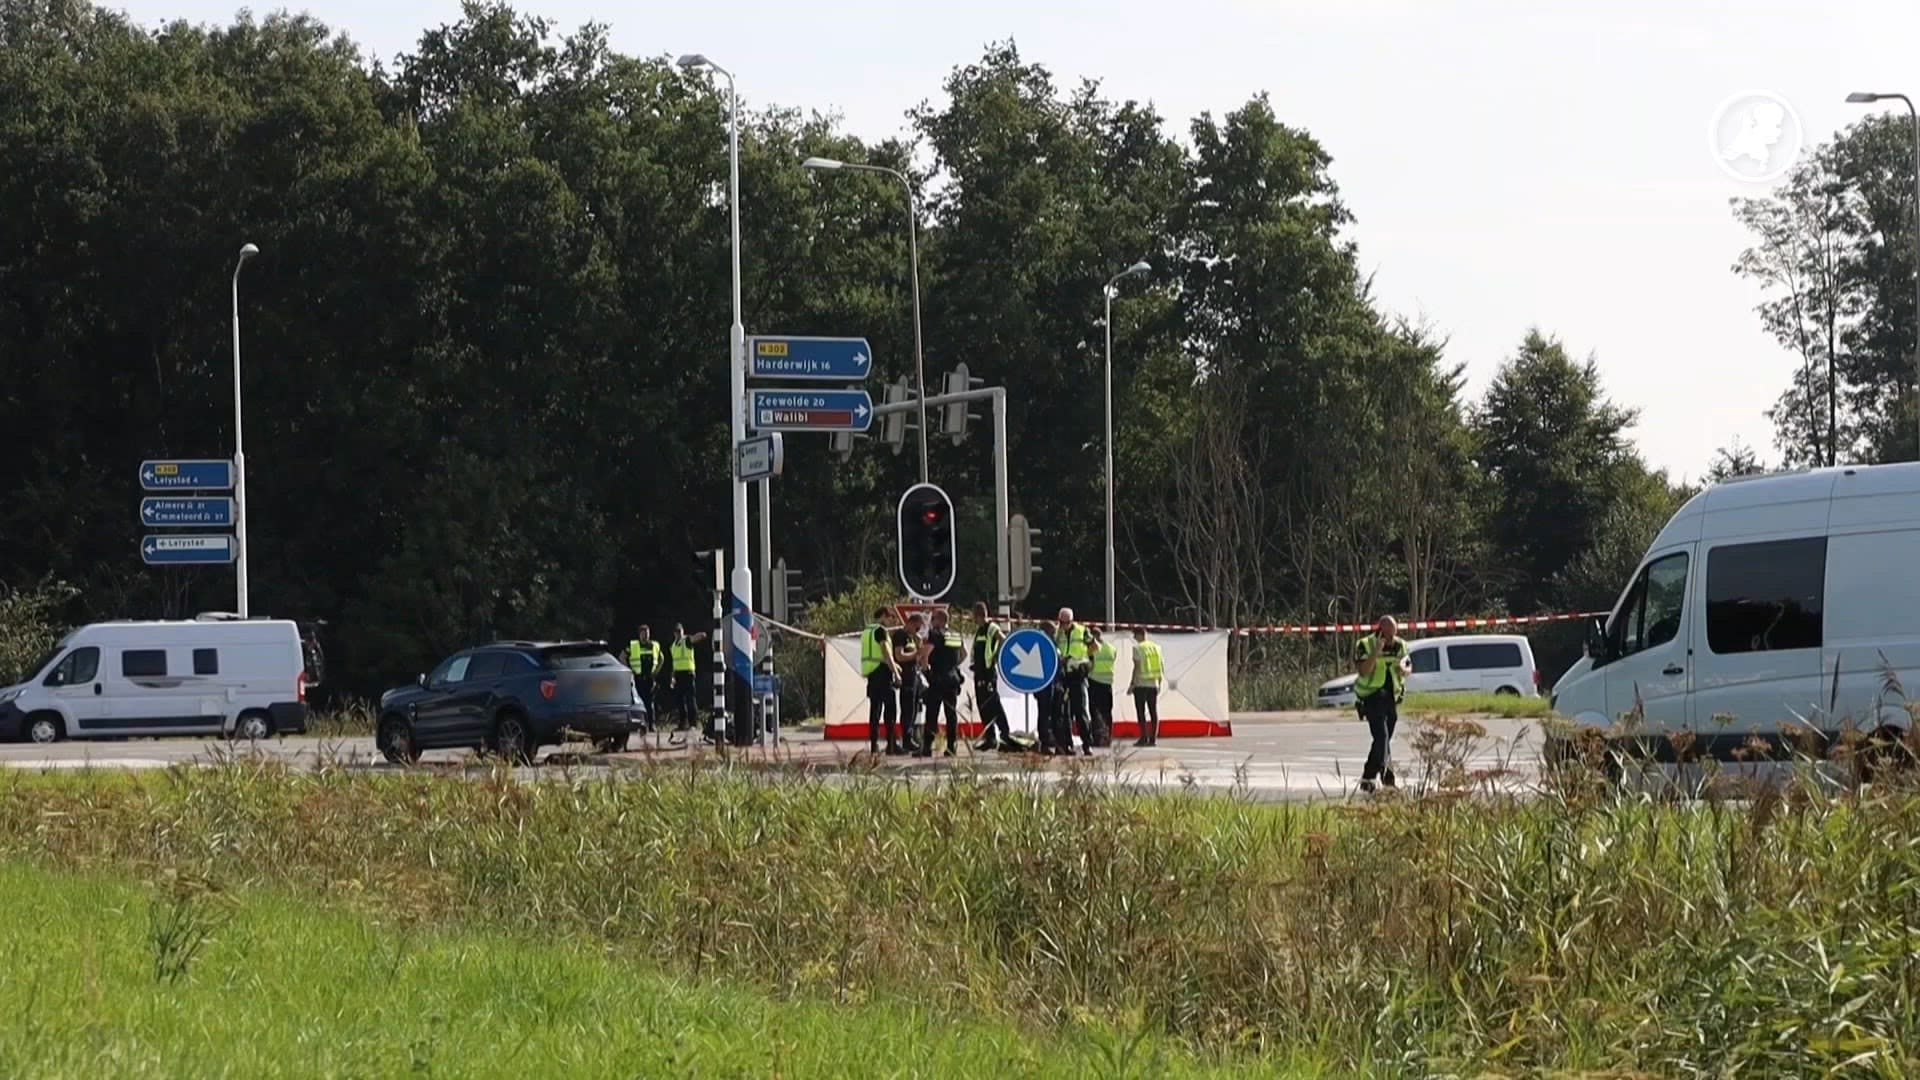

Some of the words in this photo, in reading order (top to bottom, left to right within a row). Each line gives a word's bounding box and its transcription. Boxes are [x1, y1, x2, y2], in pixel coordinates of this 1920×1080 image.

[757, 359, 818, 373] Harderwijk
[821, 361, 831, 370] 16
[758, 396, 810, 407] Zeewolde
[813, 398, 825, 407] 20
[774, 411, 808, 423] Walibi
